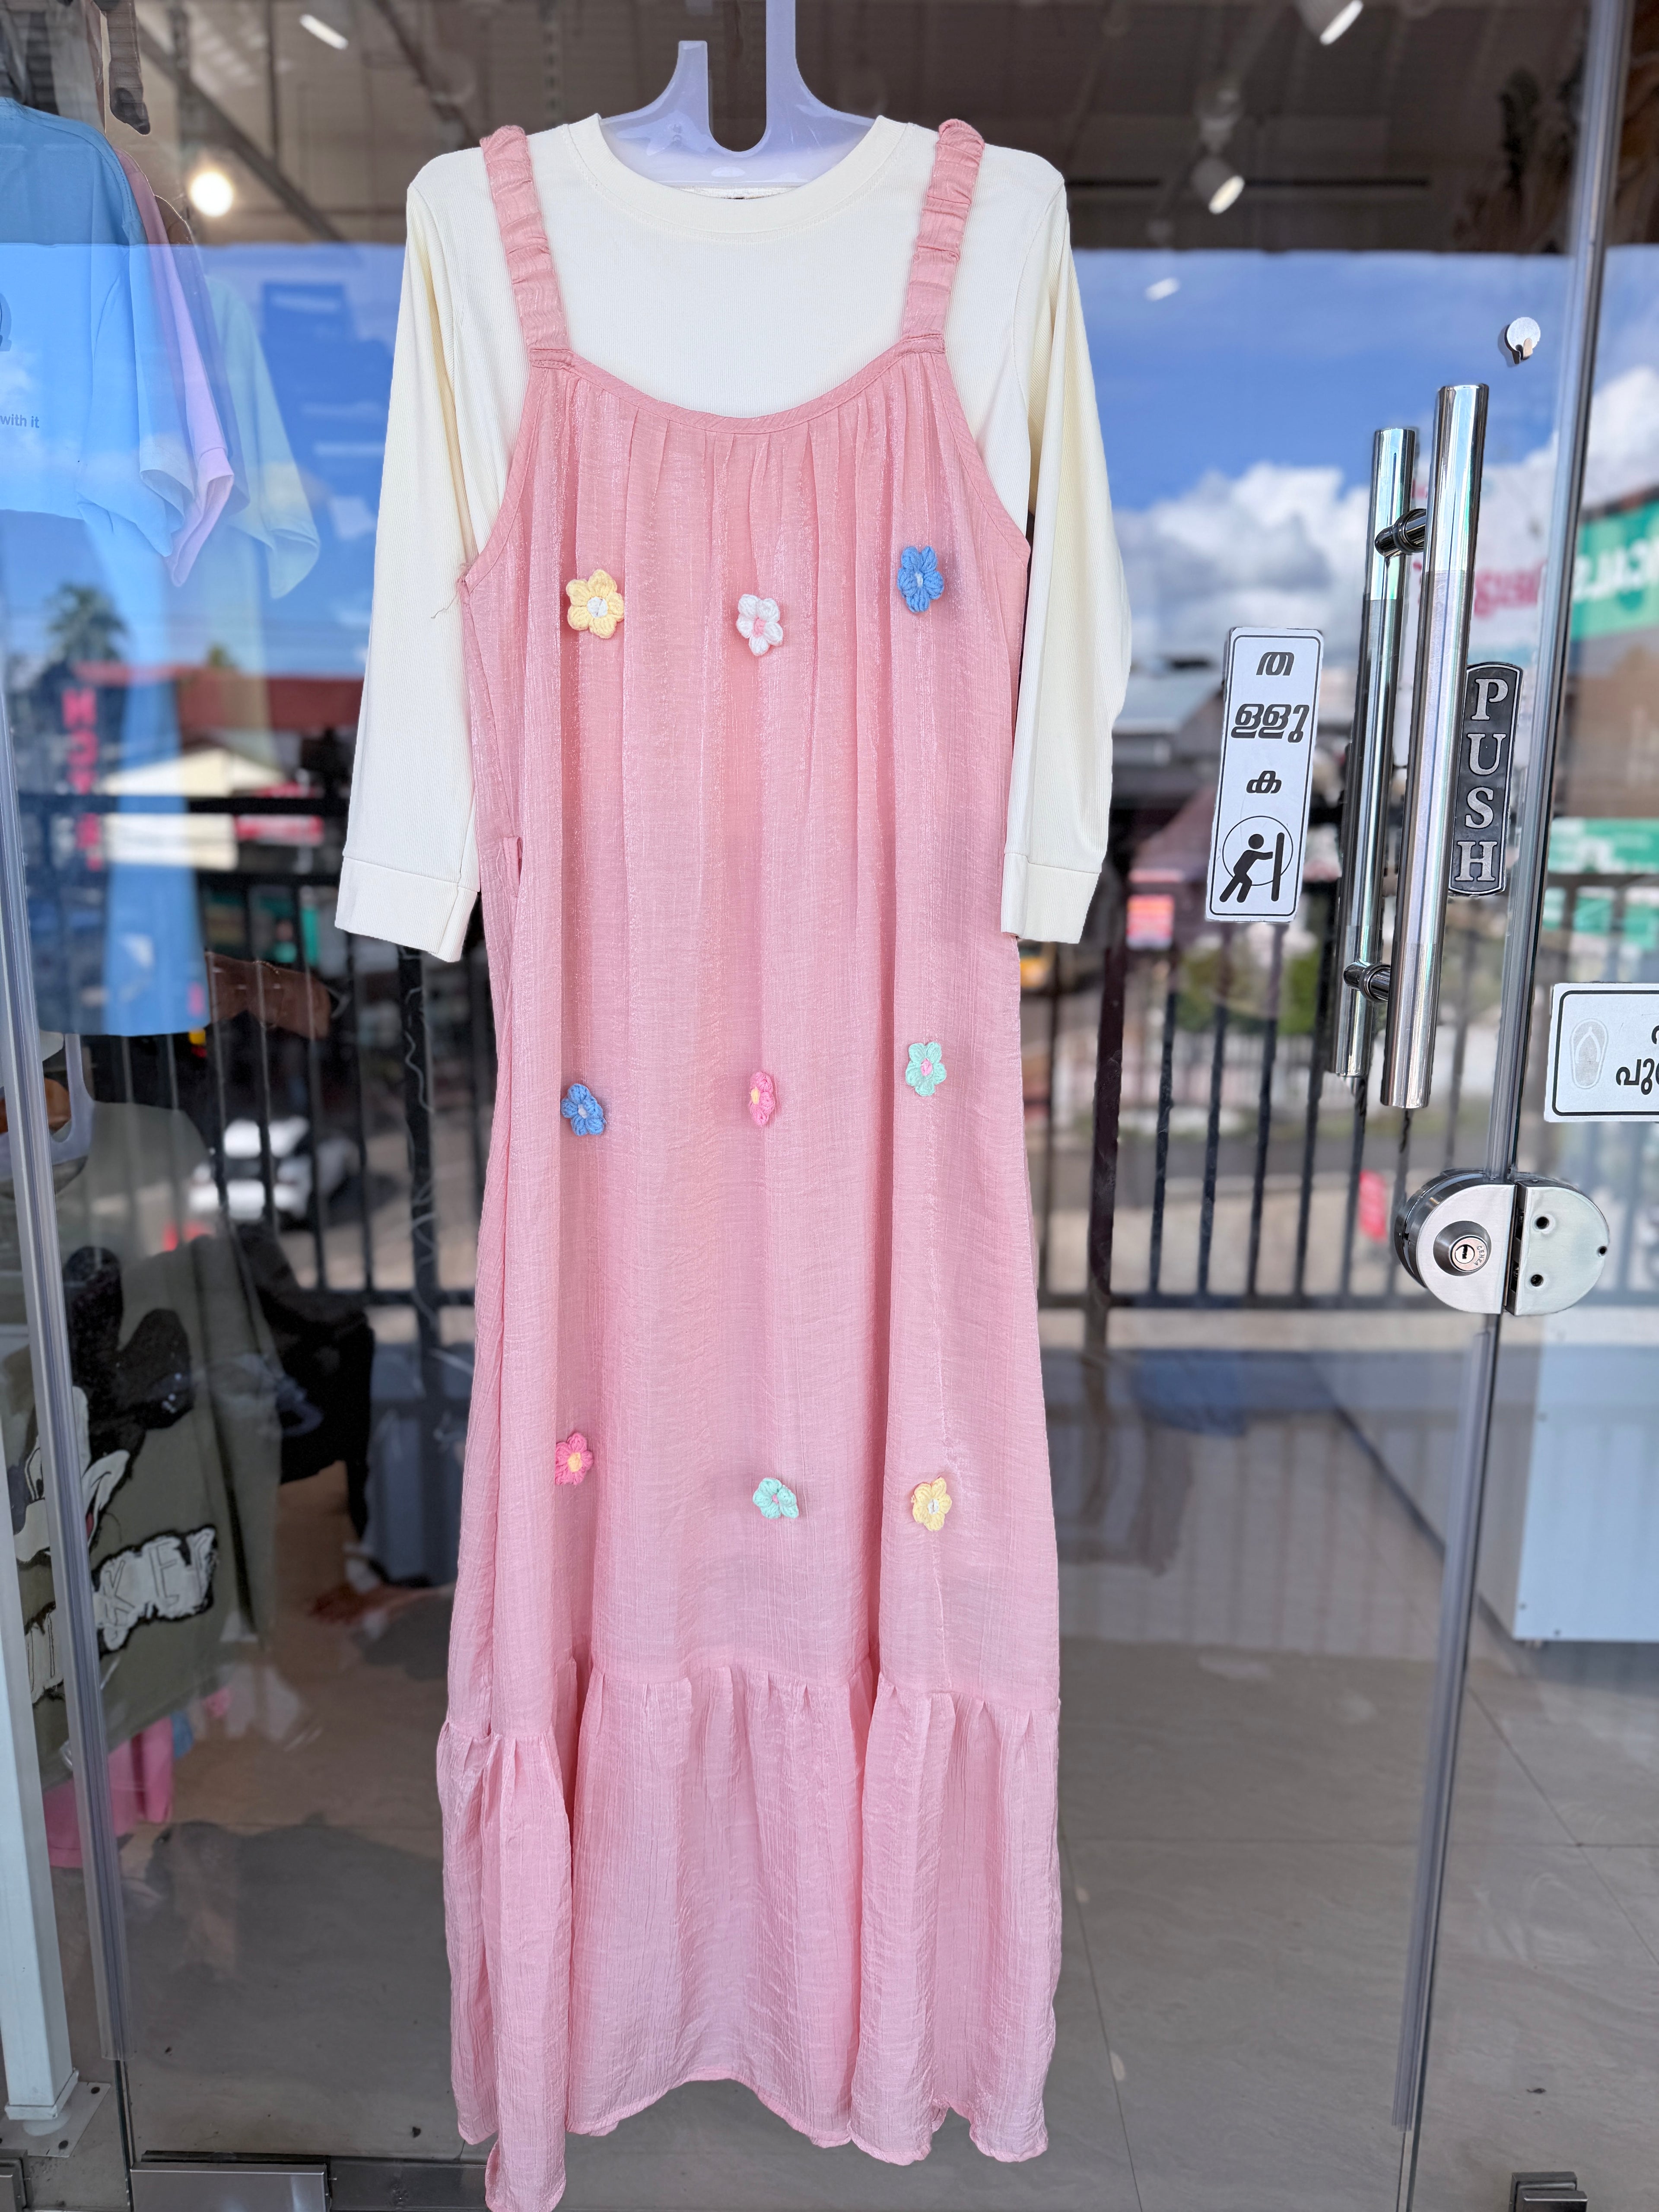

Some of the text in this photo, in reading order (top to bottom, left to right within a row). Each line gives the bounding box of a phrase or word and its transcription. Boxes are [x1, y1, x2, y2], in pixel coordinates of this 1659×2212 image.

[0, 413, 40, 428] with it
[1455, 678, 1509, 882] PUSH
